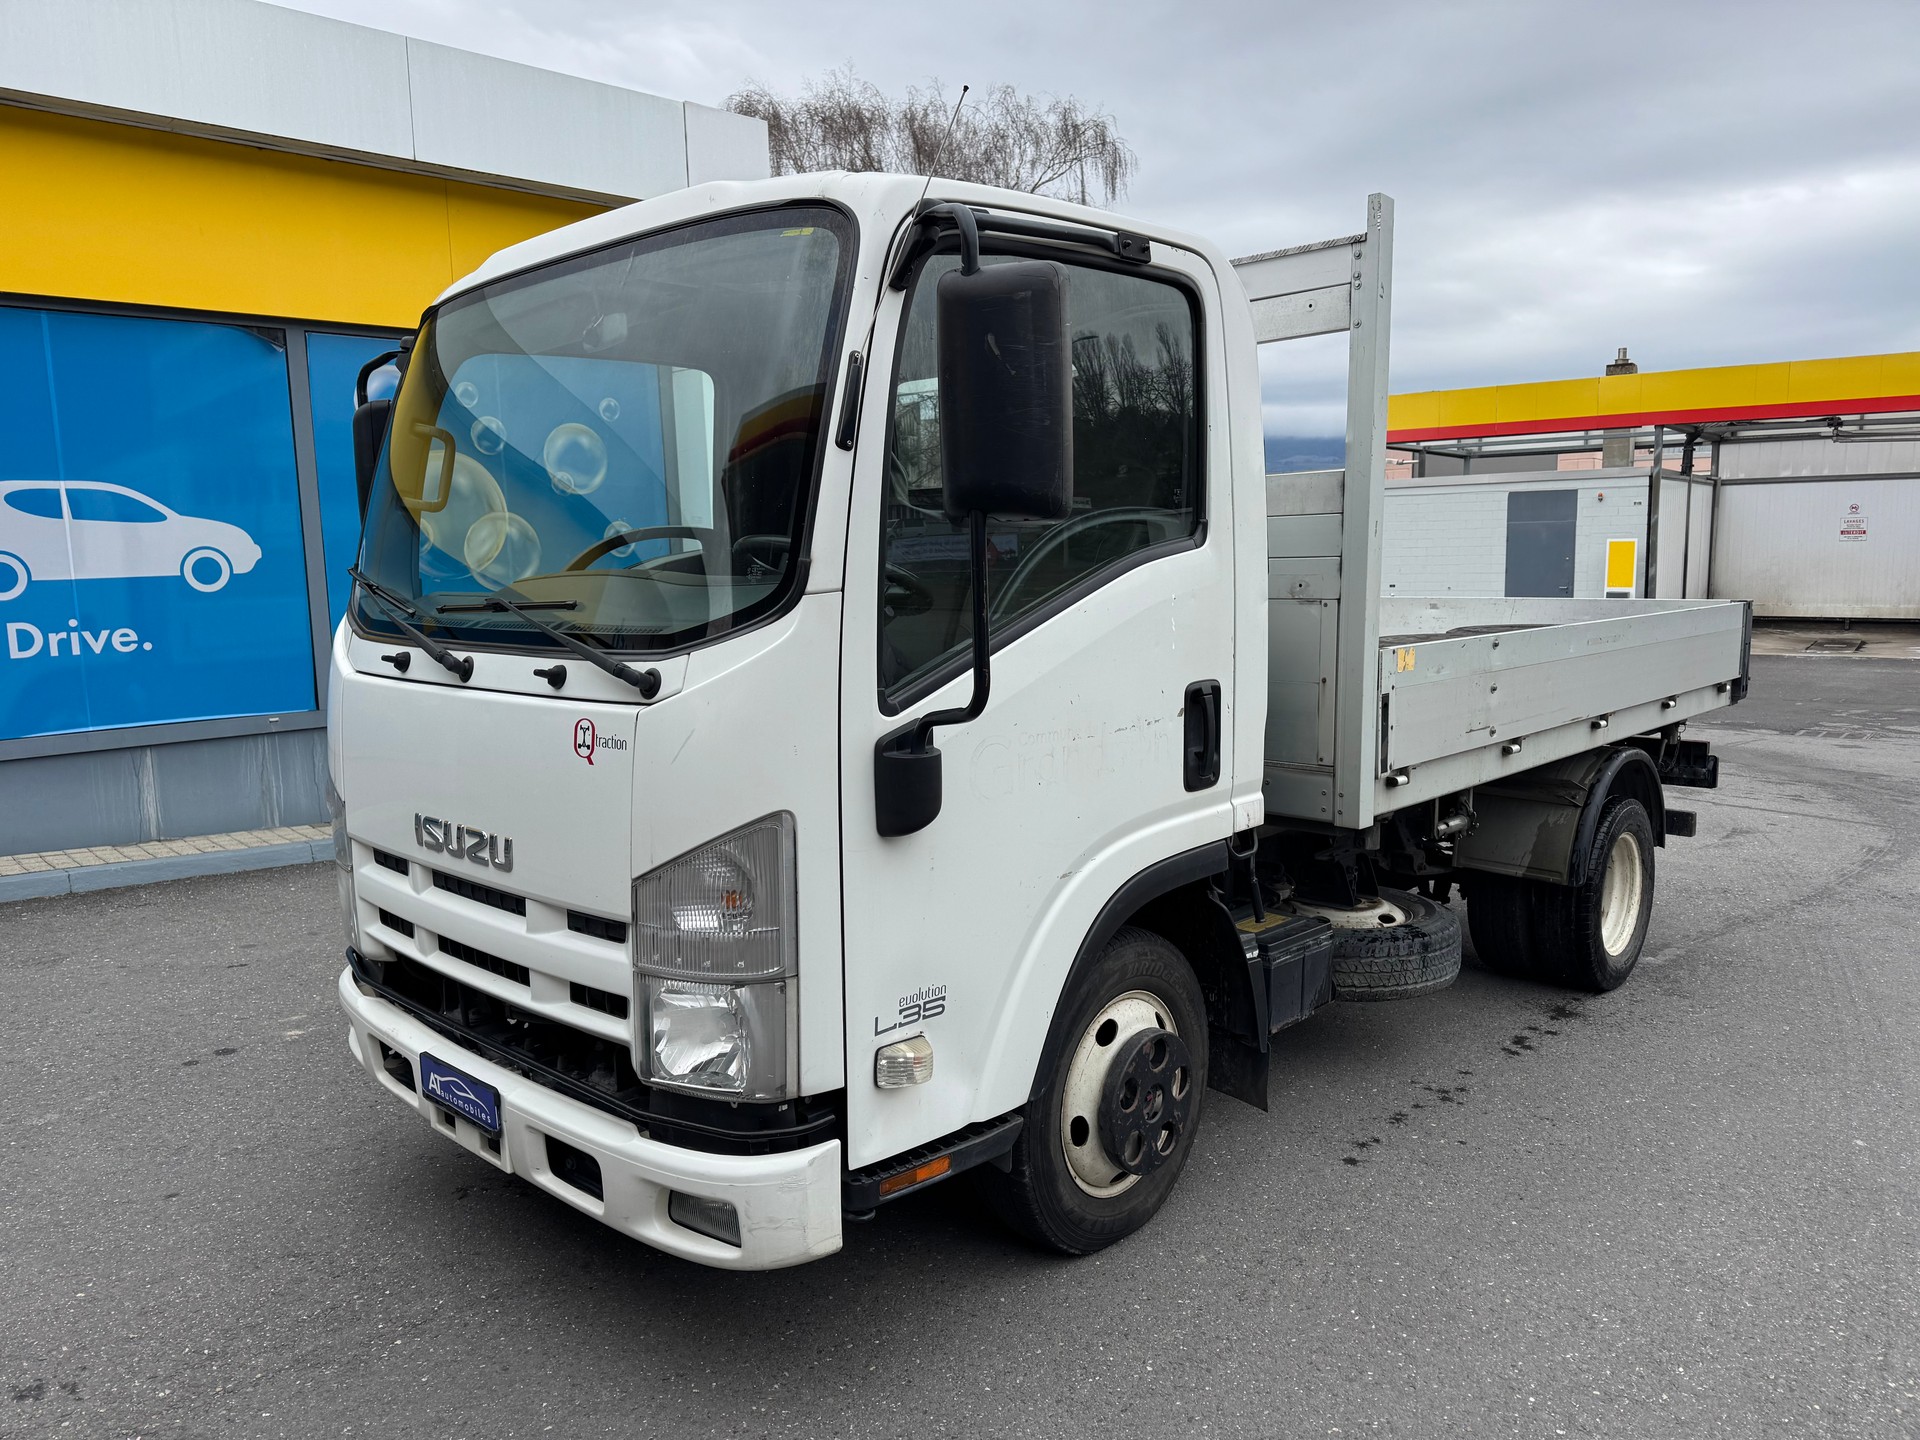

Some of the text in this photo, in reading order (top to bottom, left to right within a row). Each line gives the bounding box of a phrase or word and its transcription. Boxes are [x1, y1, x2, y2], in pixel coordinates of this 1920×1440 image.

[6, 618, 153, 659] Drive.
[414, 812, 514, 873] ISUZU
[874, 995, 946, 1037] L35
[899, 984, 947, 1008] evolution
[440, 1089, 492, 1124] automobiles
